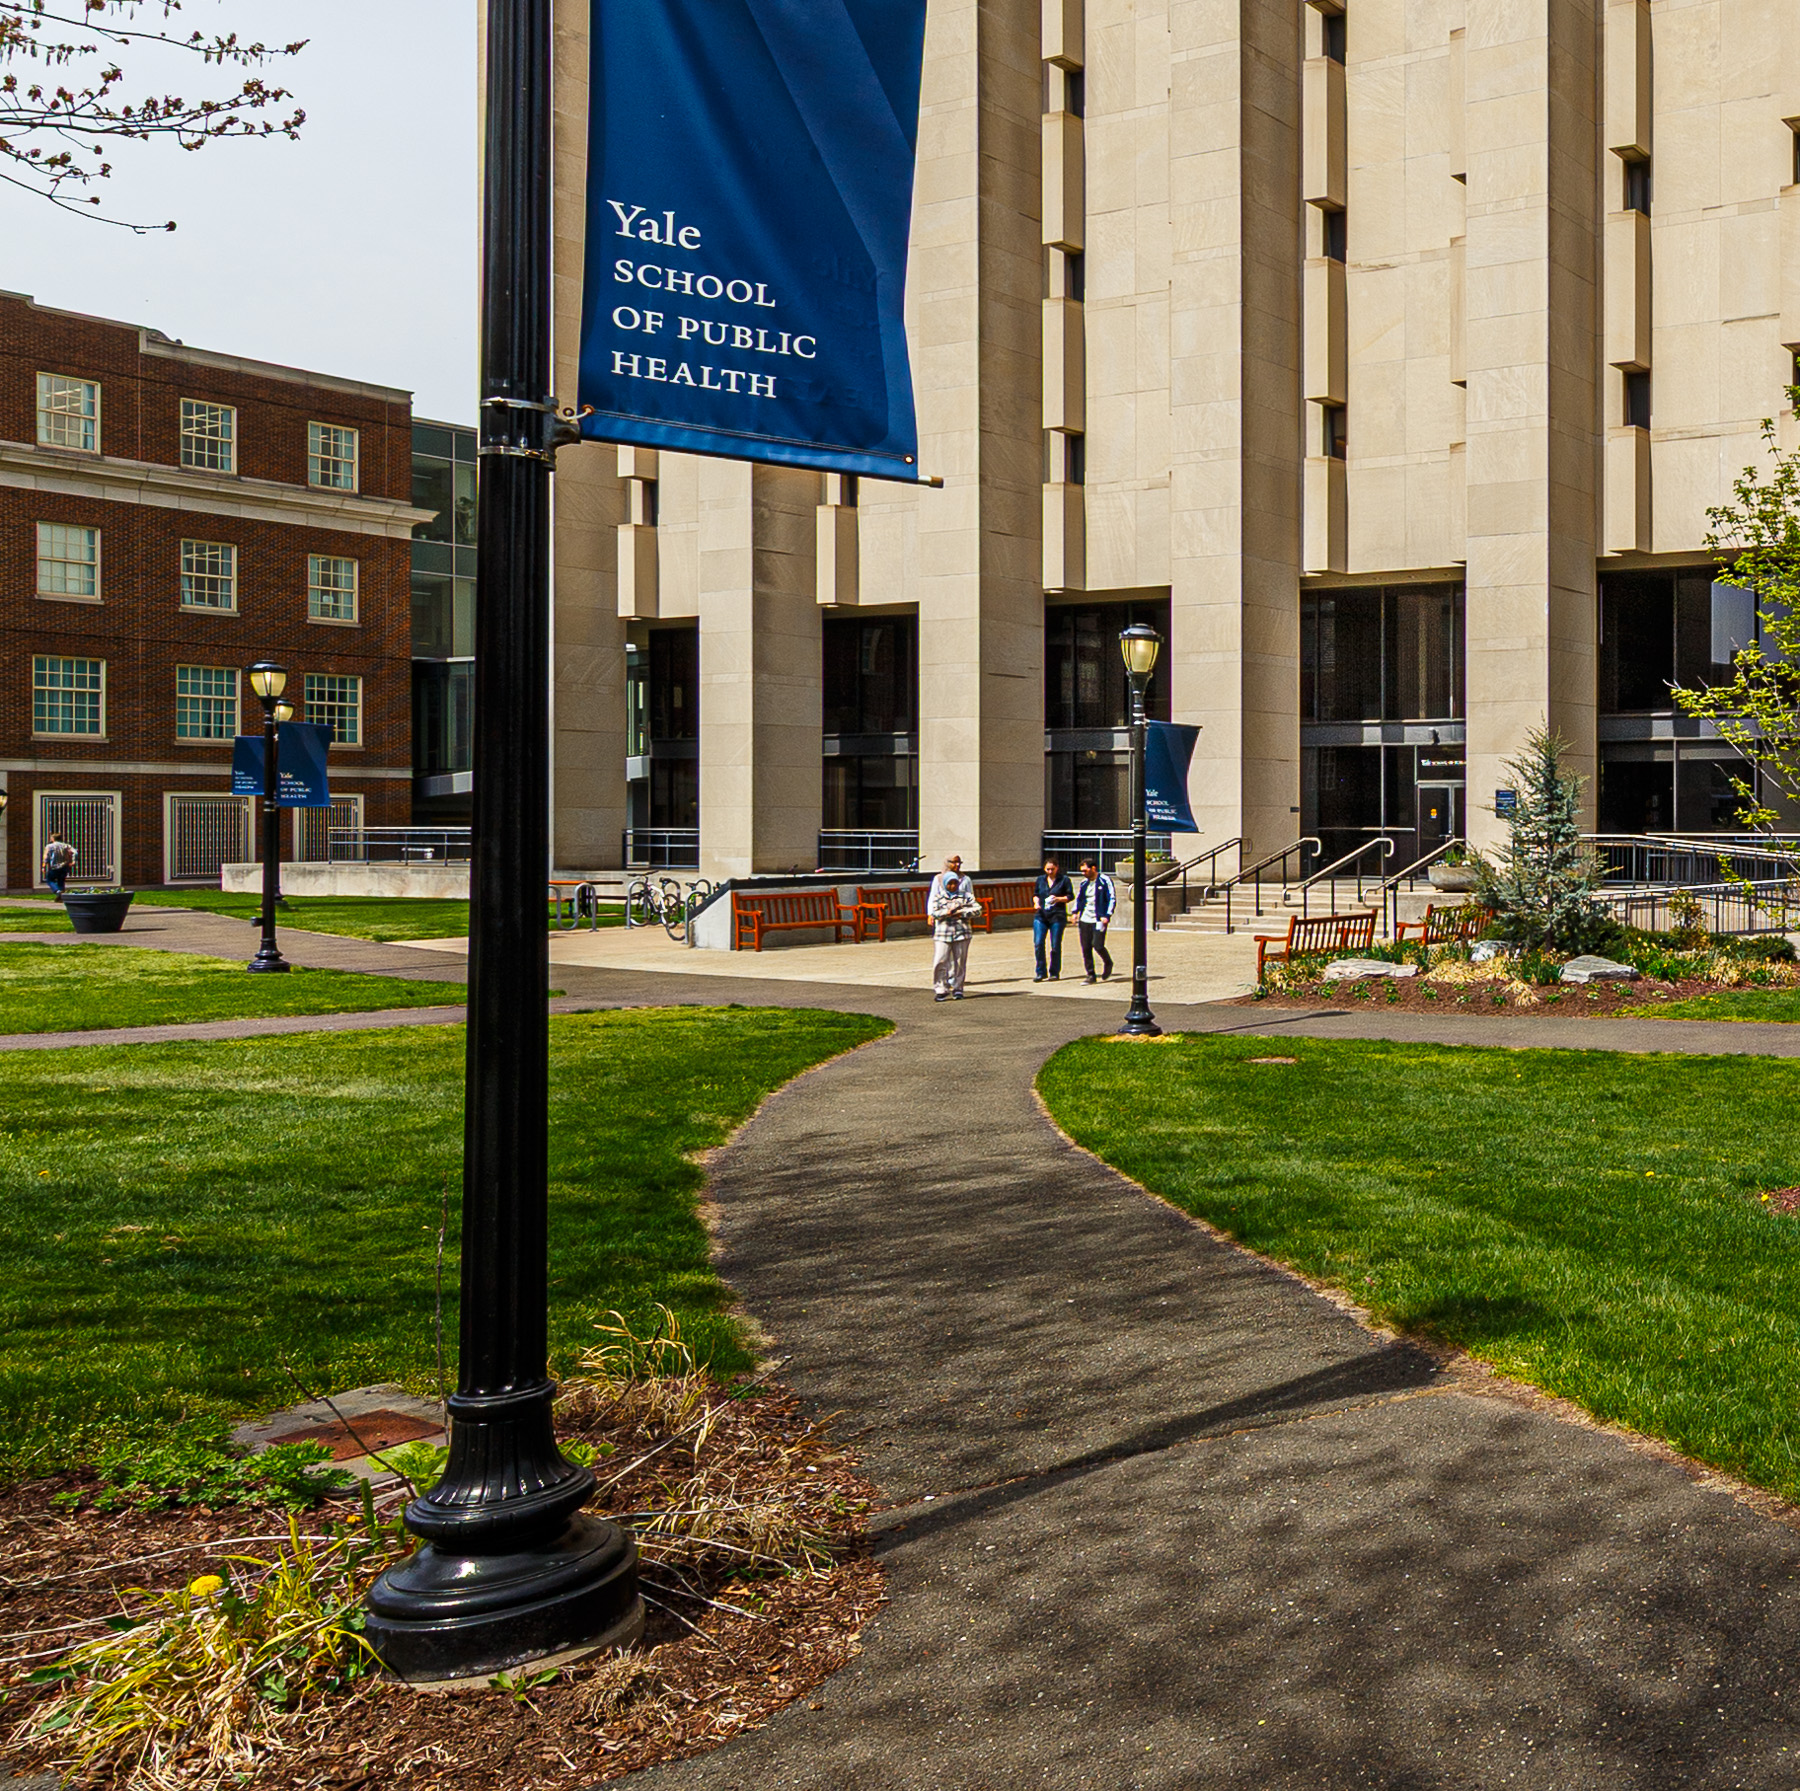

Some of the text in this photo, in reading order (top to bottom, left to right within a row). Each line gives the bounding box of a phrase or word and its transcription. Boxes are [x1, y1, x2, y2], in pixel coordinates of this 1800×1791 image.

[607, 199, 702, 250] Yale
[613, 259, 776, 308] SCHOOL
[612, 306, 817, 359] OF PUBLIC
[611, 350, 777, 399] HEALTH
